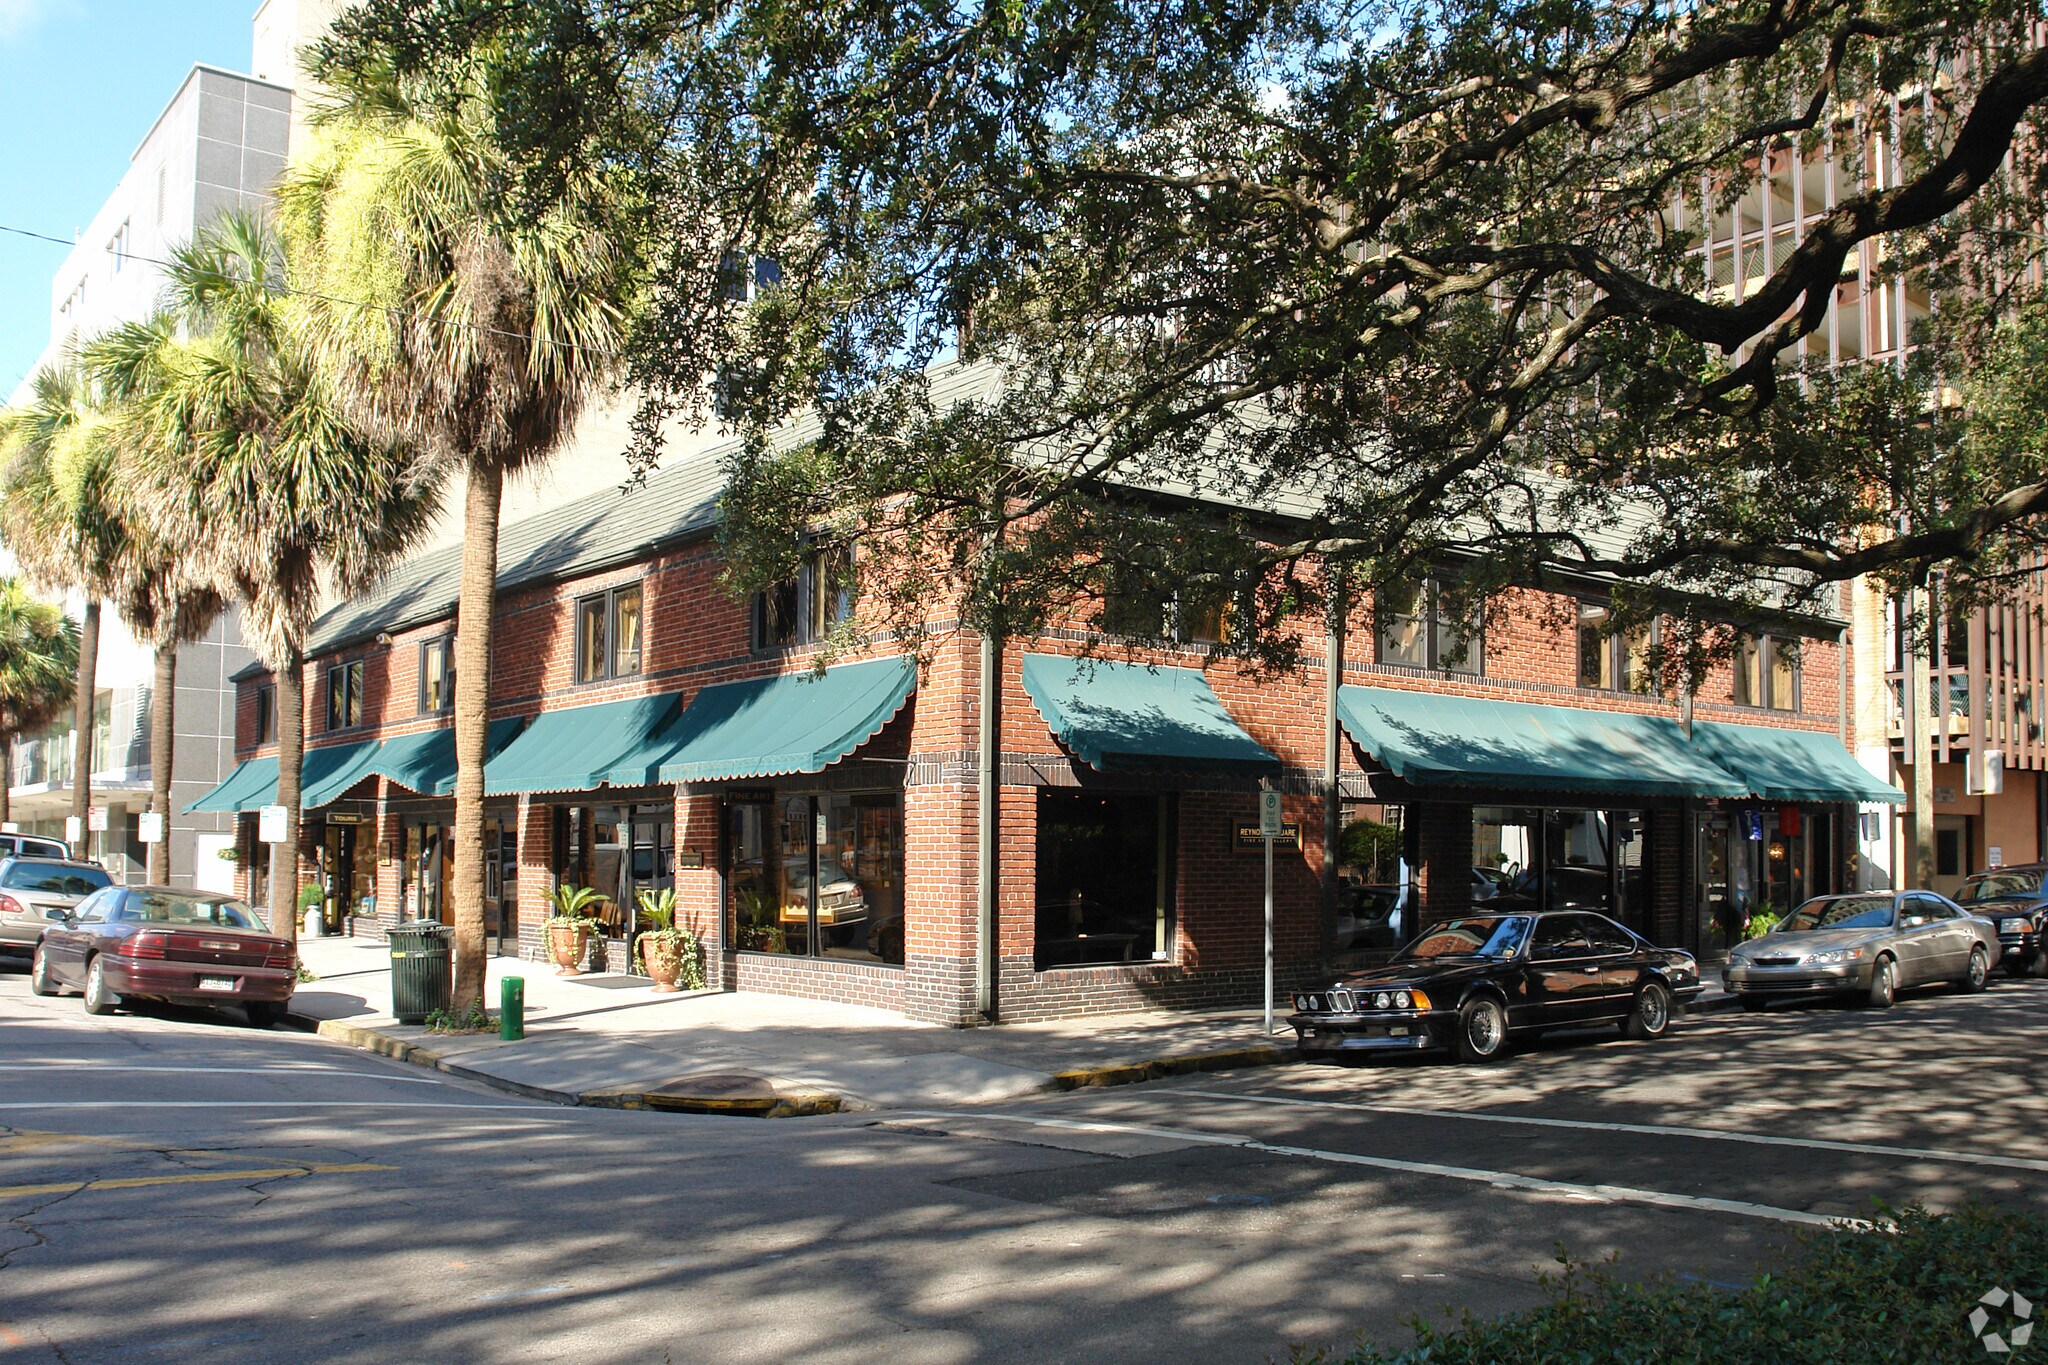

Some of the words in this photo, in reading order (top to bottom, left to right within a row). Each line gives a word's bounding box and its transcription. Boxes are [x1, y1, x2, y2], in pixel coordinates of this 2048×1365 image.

[728, 792, 751, 800] FINE
[752, 792, 771, 800] ART
[1240, 828, 1262, 836] REYNO
